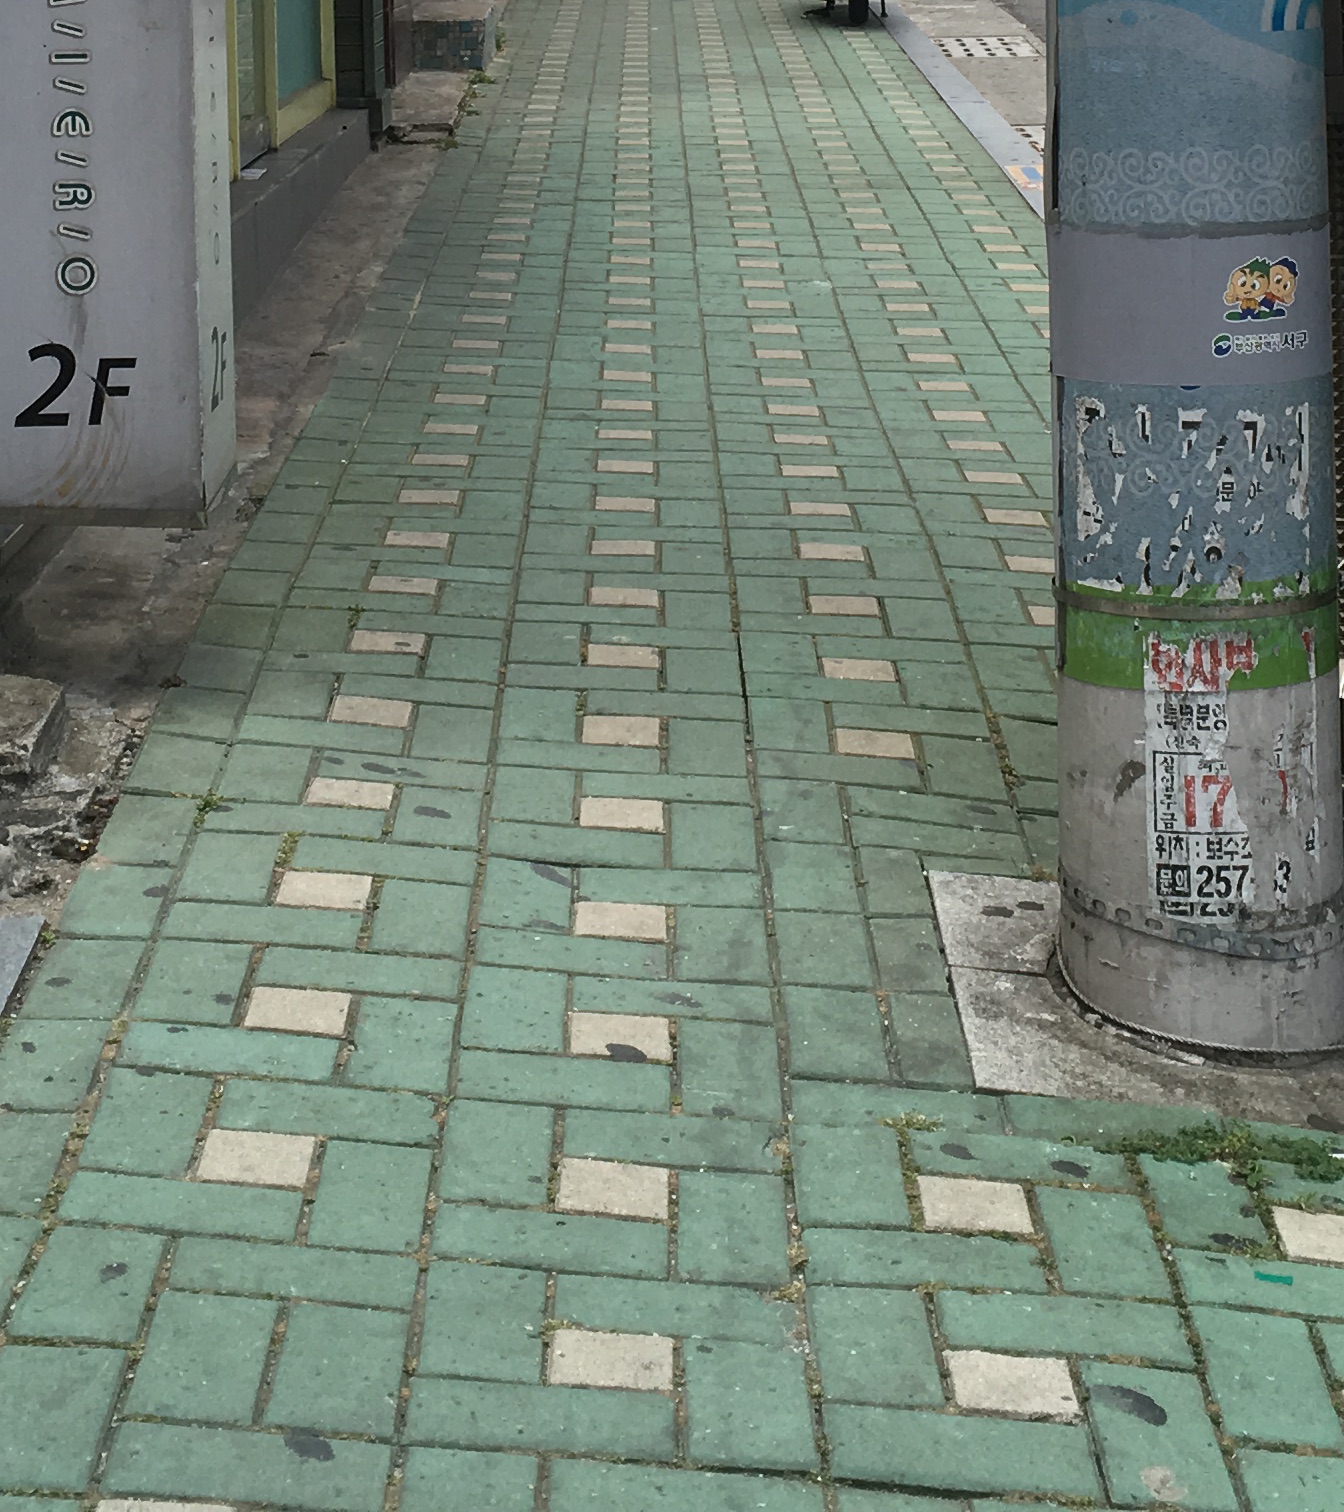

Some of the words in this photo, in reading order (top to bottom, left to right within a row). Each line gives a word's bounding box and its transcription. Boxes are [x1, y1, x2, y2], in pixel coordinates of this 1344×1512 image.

[1281, 330, 1308, 349] 서구
[14, 341, 138, 428] 2F
[210, 325, 228, 413] 2F
[1184, 774, 1233, 828] 17
[1155, 834, 1190, 860] 위치
[1196, 864, 1250, 899] 257
